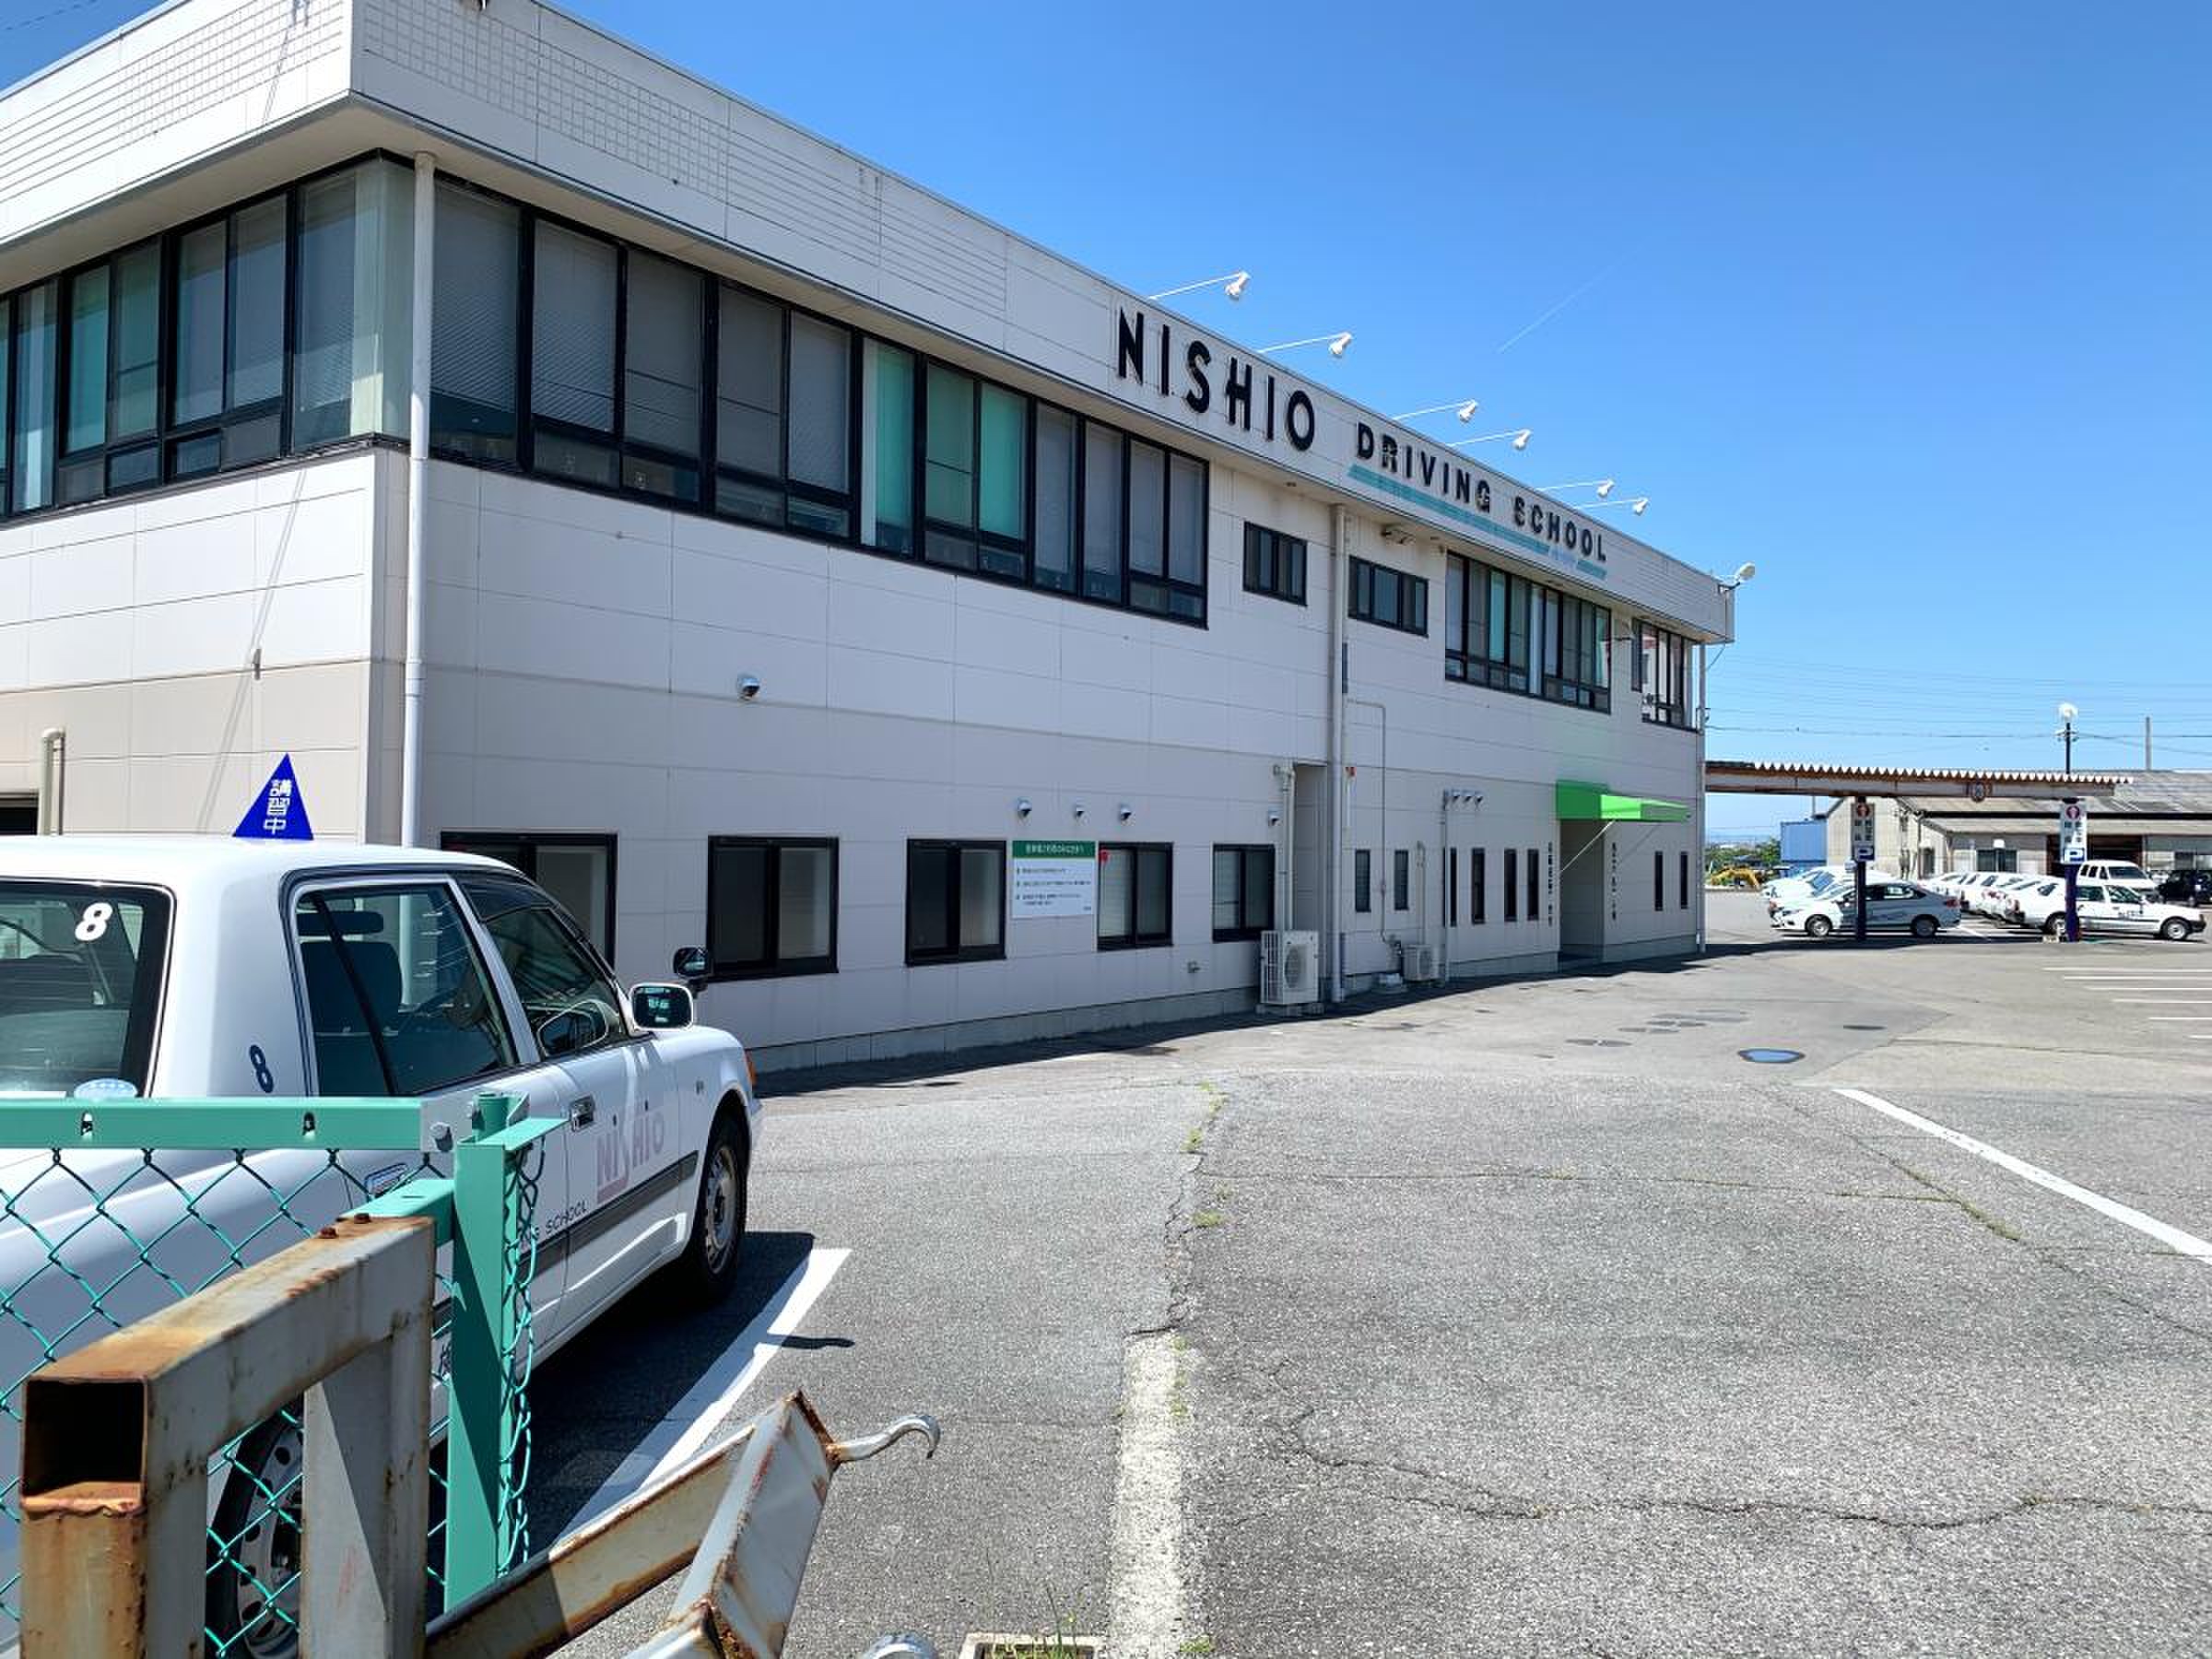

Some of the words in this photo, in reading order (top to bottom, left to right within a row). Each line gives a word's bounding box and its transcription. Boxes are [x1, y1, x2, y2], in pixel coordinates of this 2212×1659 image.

[1117, 307, 1315, 451] NISHIO
[1356, 421, 1491, 514] DRIVING
[1512, 495, 1607, 563] SCHOOL
[263, 778, 293, 835] 講習中
[74, 901, 113, 942] 8
[248, 1043, 275, 1094] 8
[546, 1200, 589, 1236] SCHOOL
